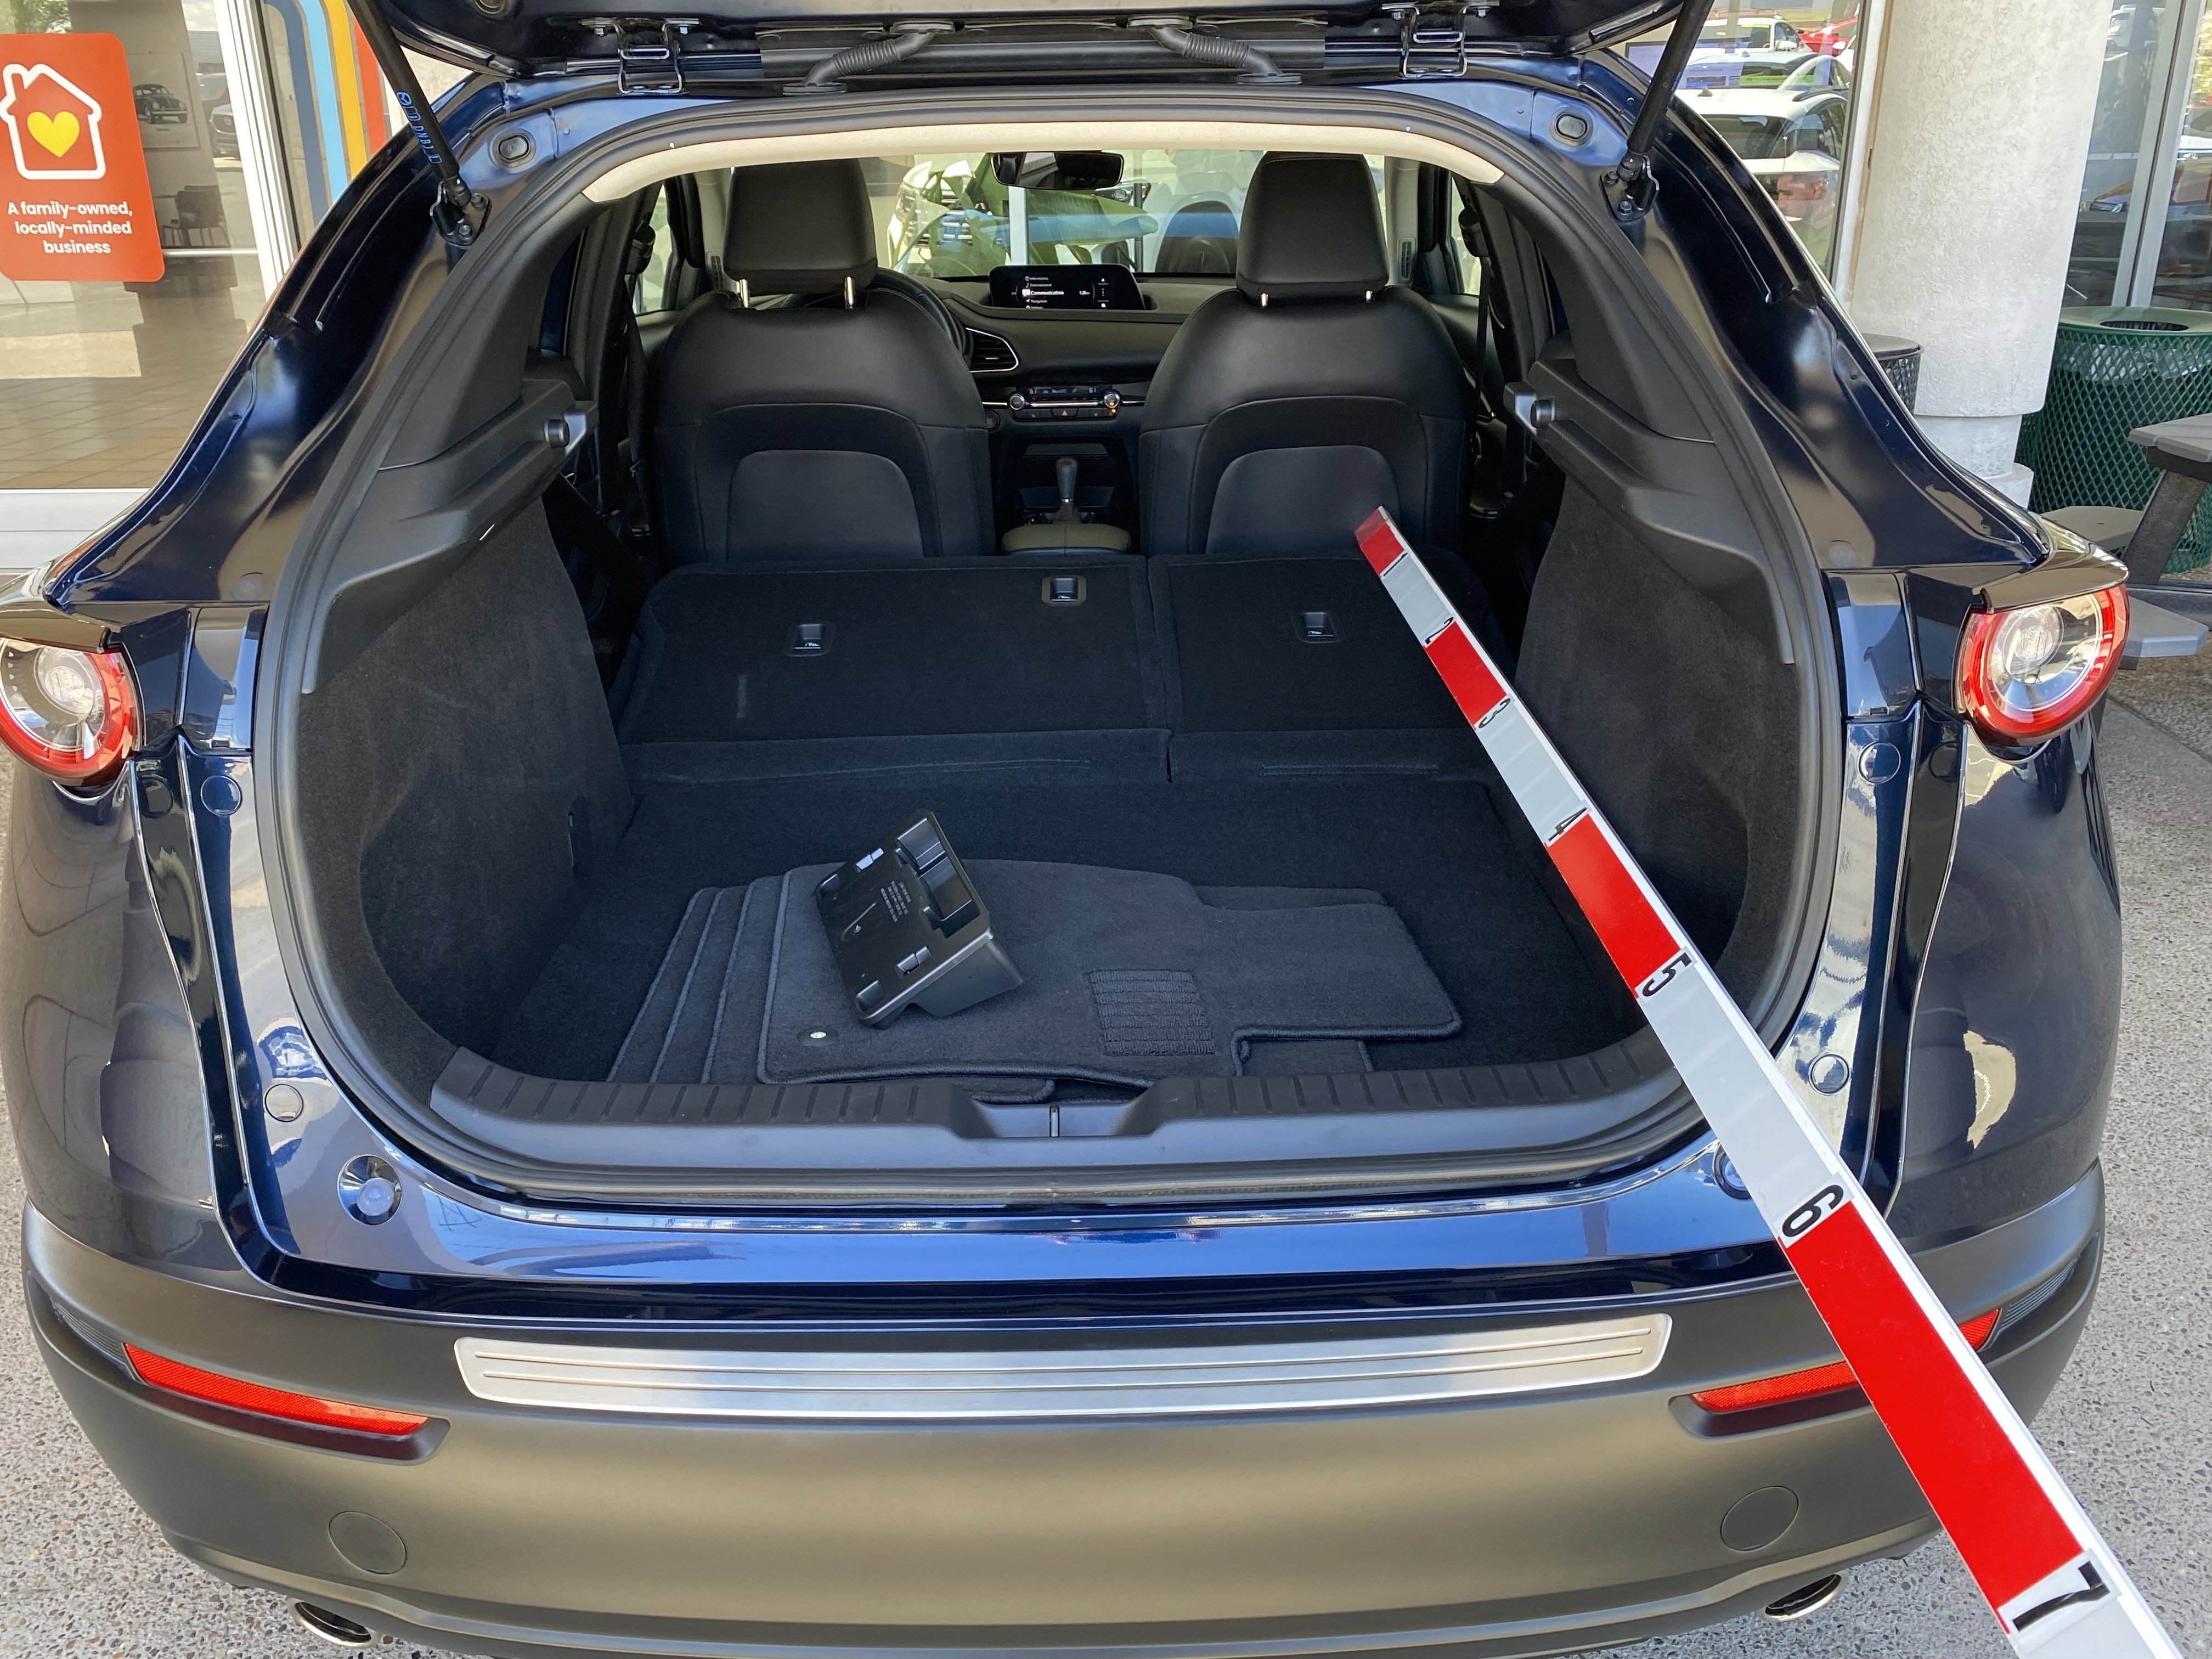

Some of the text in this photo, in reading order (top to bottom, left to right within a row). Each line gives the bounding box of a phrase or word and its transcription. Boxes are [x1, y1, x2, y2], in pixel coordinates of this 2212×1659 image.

[8, 200, 133, 218] A family-owned,
[14, 220, 132, 238] locally-minded
[42, 239, 111, 253] business
[1383, 552, 1408, 578] 1
[1425, 616, 1454, 645] 2
[1479, 697, 1511, 729] 3
[1548, 806, 1587, 841] 4
[1641, 951, 1692, 997] 5
[1781, 1184, 1844, 1239] 6
[2013, 1560, 2109, 1632] 7
